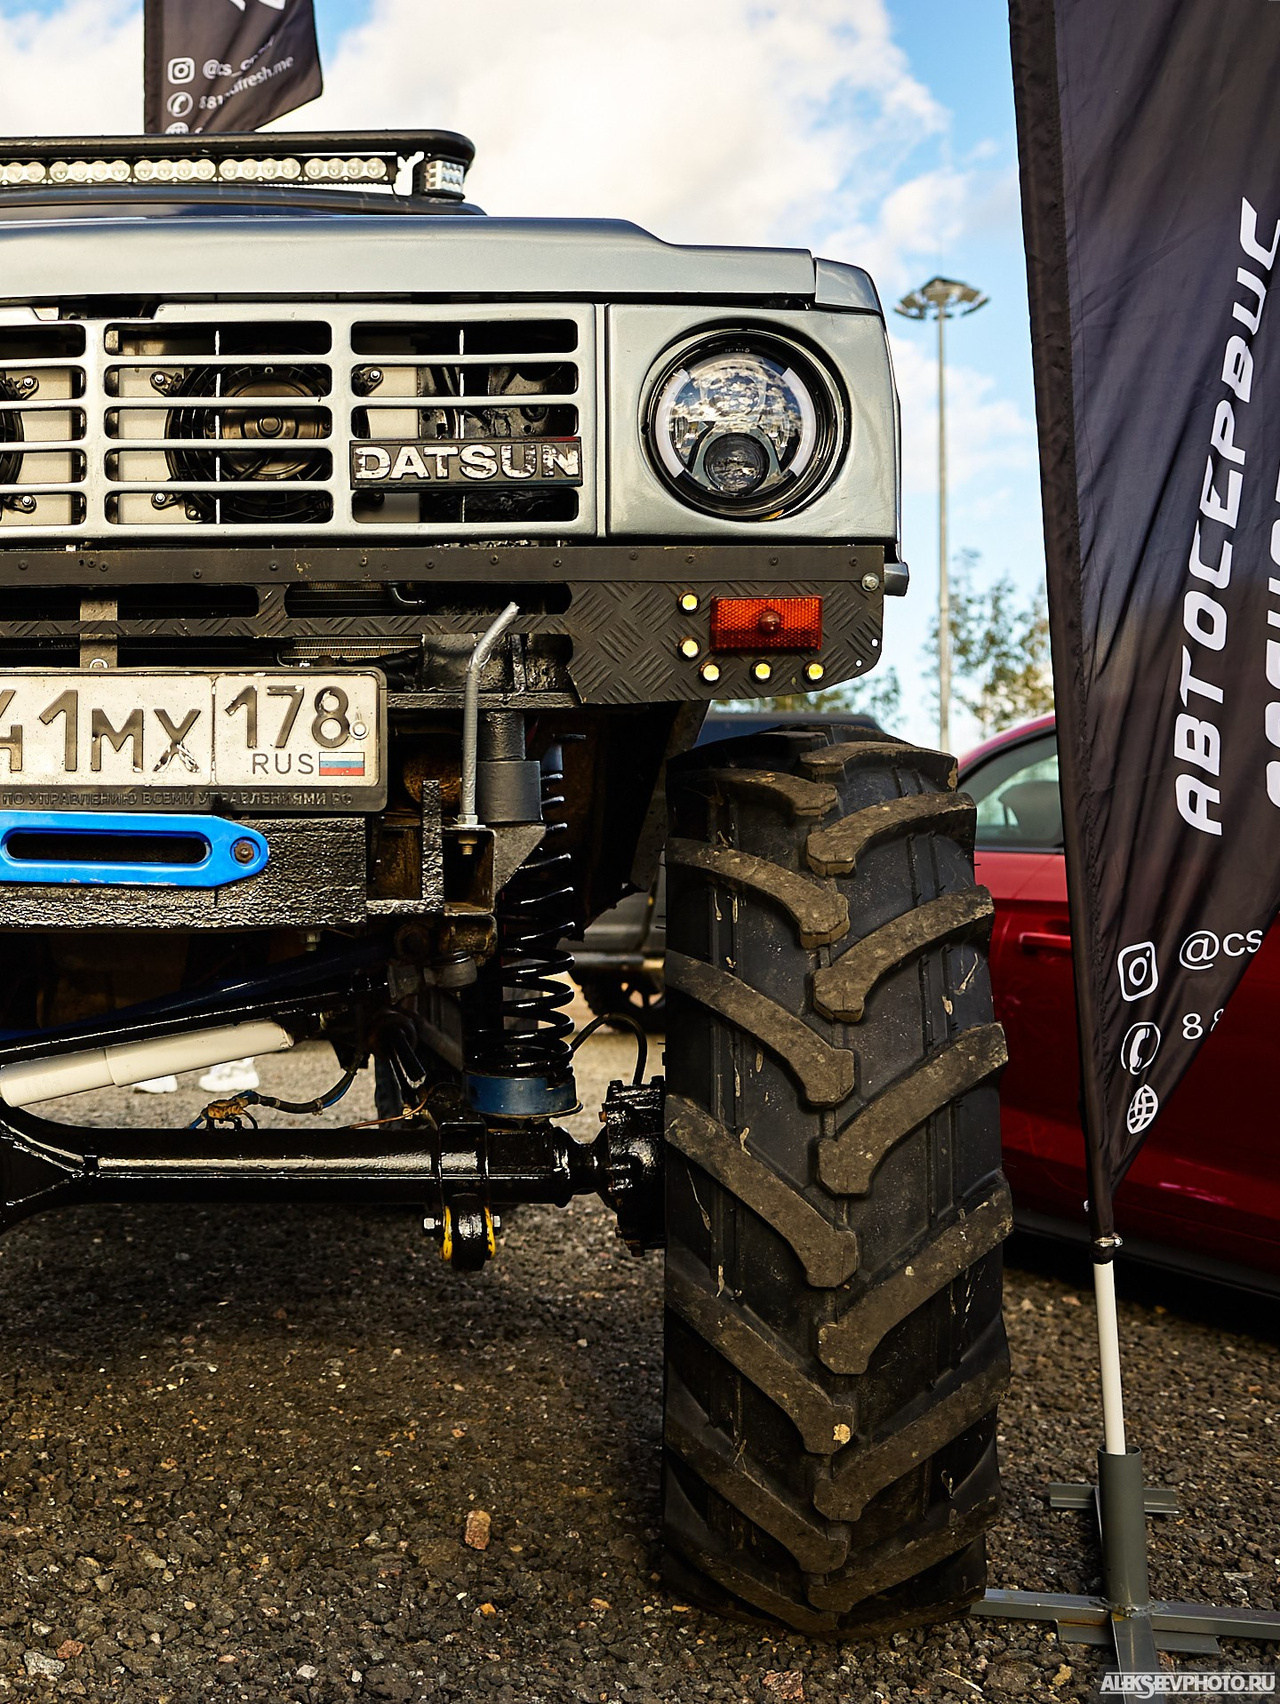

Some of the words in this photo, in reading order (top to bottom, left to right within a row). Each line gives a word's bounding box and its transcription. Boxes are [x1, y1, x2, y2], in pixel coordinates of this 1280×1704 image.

[354, 444, 579, 480] DATSUN
[1174, 196, 1280, 836] АВТОСЕРВИС
[224, 685, 351, 750] 178
[252, 754, 314, 776] RUS
[2, 792, 25, 805] ПО
[28, 792, 137, 805] УПРАВЛЕНИЮ
[141, 791, 195, 805] ВСЕМИ
[331, 792, 354, 806] РФ
